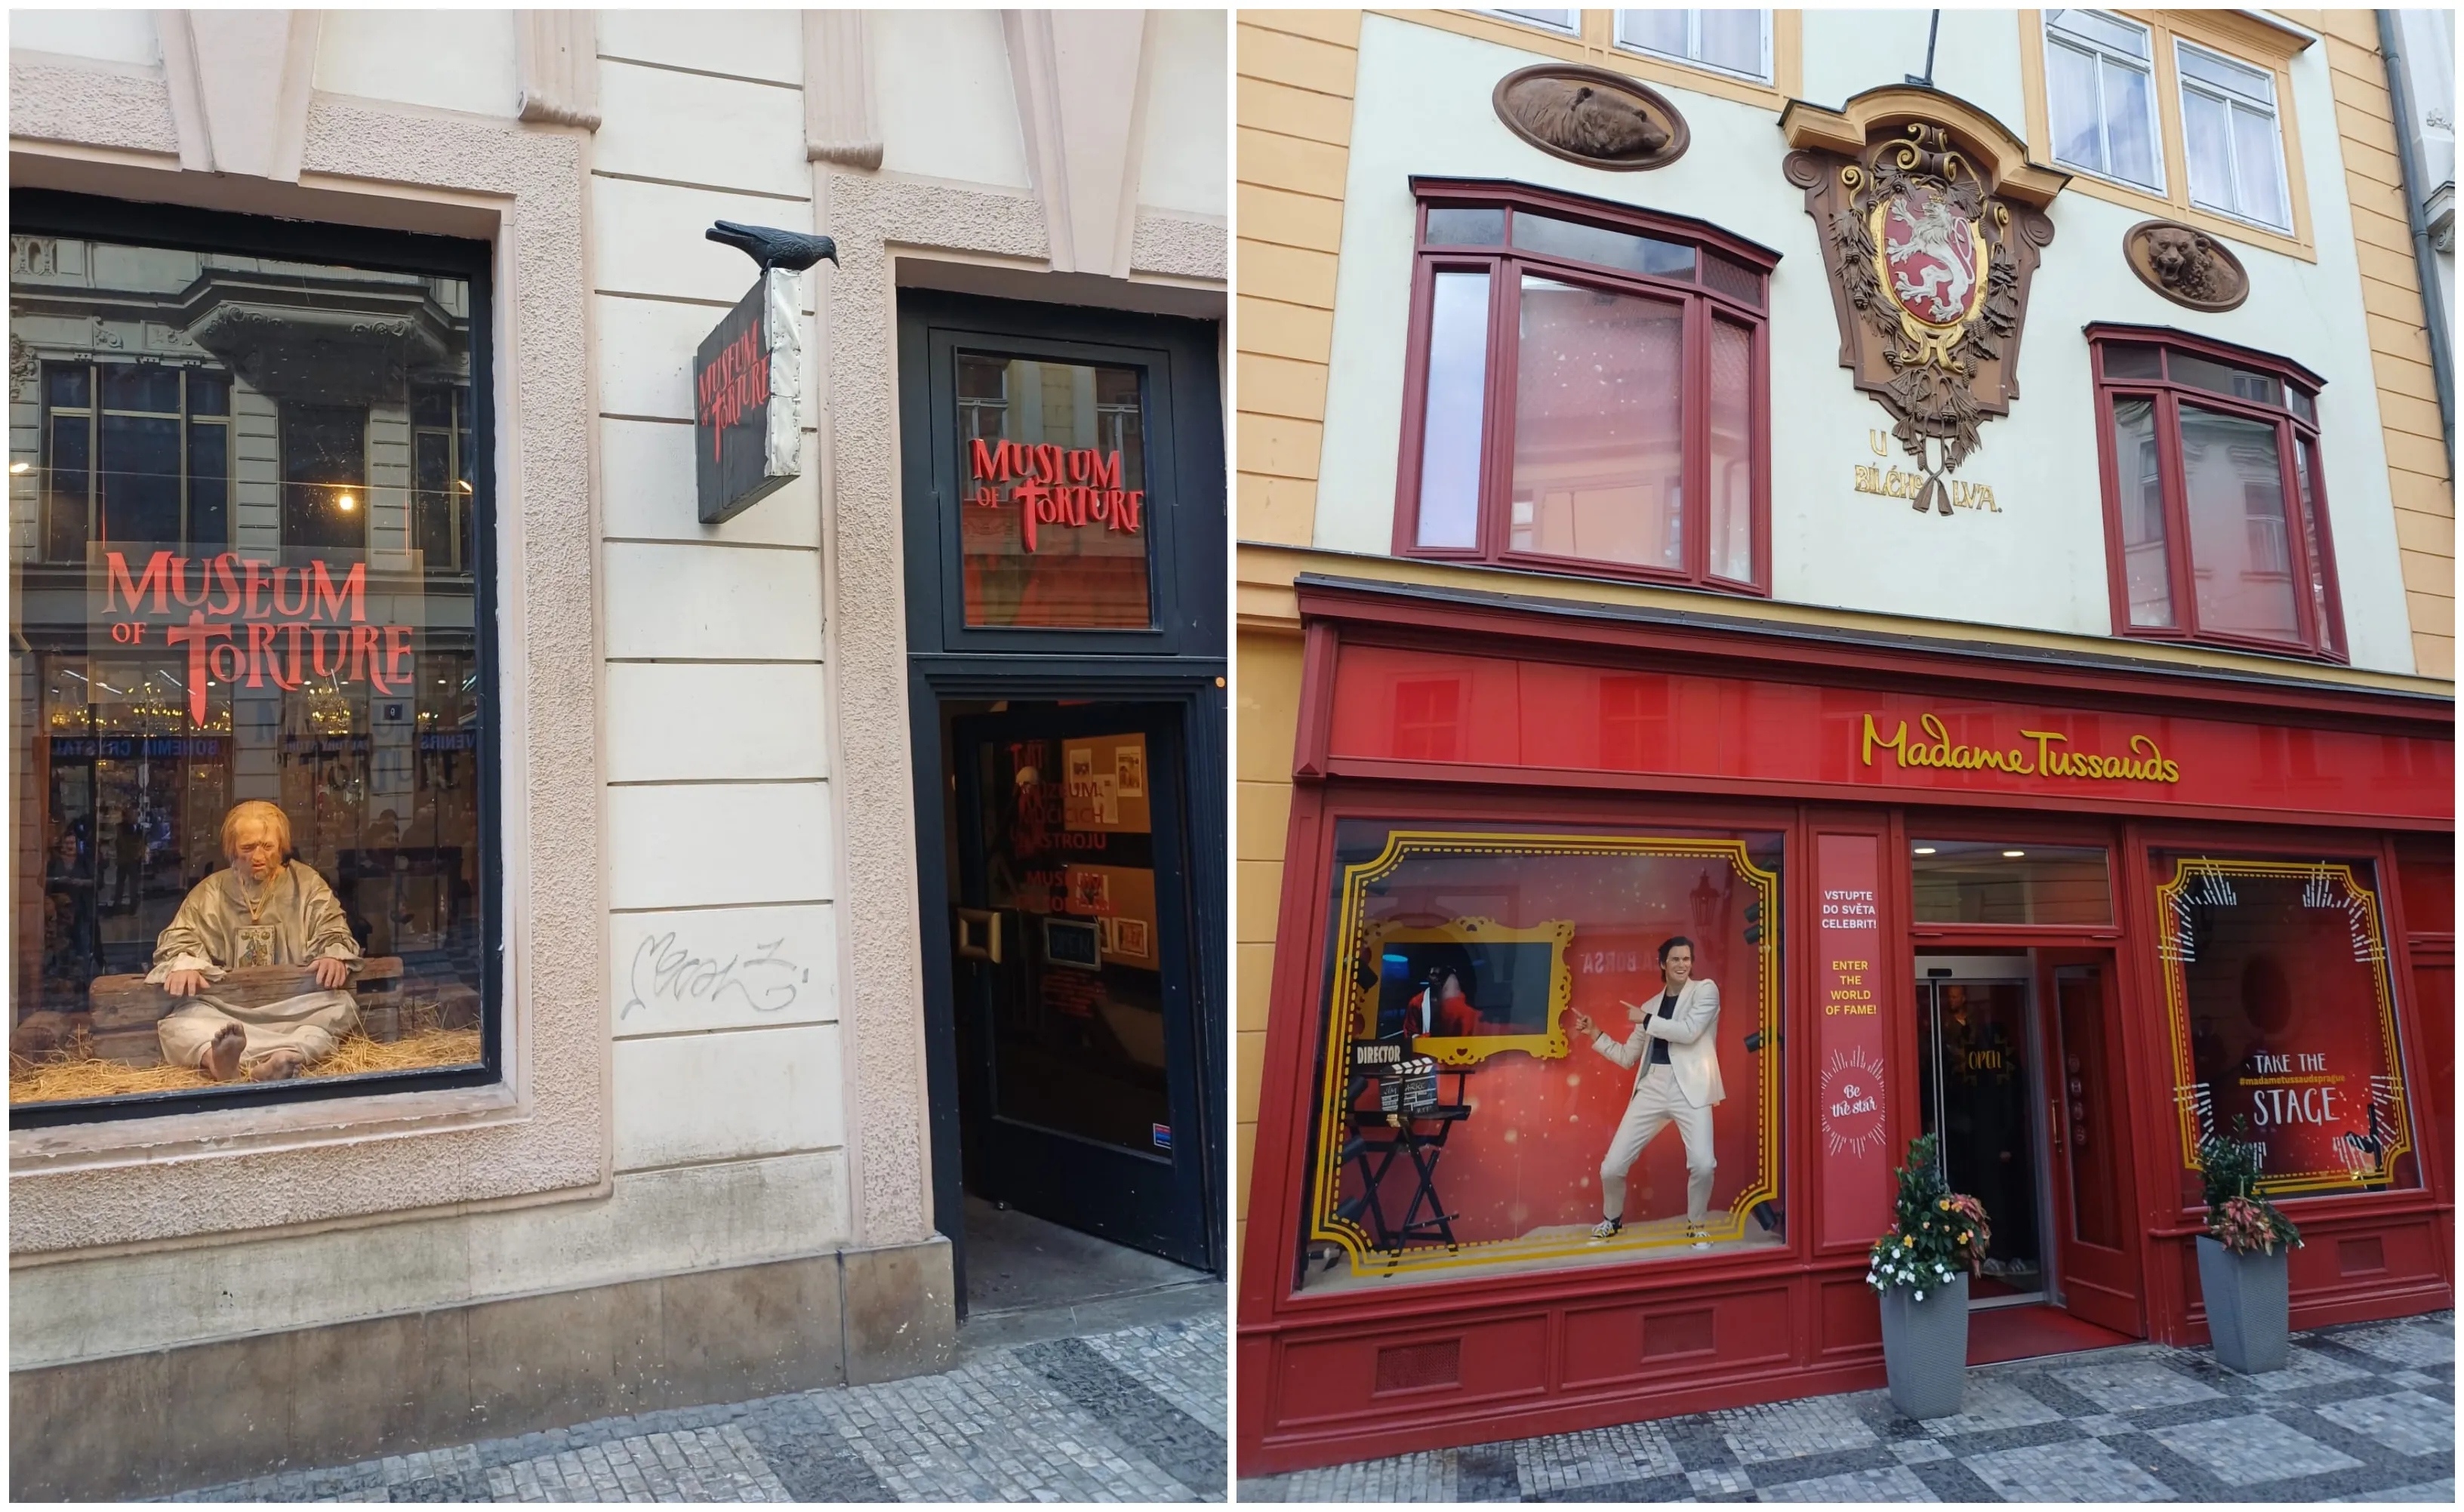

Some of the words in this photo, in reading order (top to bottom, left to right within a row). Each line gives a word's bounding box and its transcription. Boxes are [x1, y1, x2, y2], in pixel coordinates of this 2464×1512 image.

[699, 318, 758, 405] MUSEUM
[701, 410, 709, 426] OF
[712, 354, 771, 463] TORTURE
[1870, 428, 1887, 457] U
[976, 486, 1001, 508] OF
[101, 550, 367, 623] MUSEUM
[111, 622, 147, 645] OF
[167, 609, 414, 728] TORTURE
[1862, 713, 2035, 775] Madame
[2020, 729, 2179, 784] Tussauds
[1824, 890, 1873, 901] VSTUPTE
[1823, 905, 1839, 914] DO
[1842, 903, 1876, 915] SVĚTA
[1822, 919, 1877, 929] CELEBRIT!
[1832, 960, 1868, 971] ENTER
[1840, 975, 1862, 985] THE
[1831, 990, 1871, 1000] WORLD
[1825, 1005, 1840, 1015] OF
[1844, 1005, 1877, 1015] FAME!
[1357, 1045, 1400, 1064] DIRECTOR
[1968, 1049, 2002, 1070] OPEN
[2253, 1054, 2293, 1073] TAKE
[2297, 1052, 2327, 1072] THE
[2238, 1073, 2345, 1086] #madametussaudsprague
[1843, 1084, 1862, 1098] Be
[1830, 1100, 1851, 1117] the
[1852, 1096, 1877, 1113] star
[2253, 1087, 2340, 1127] STAGE
